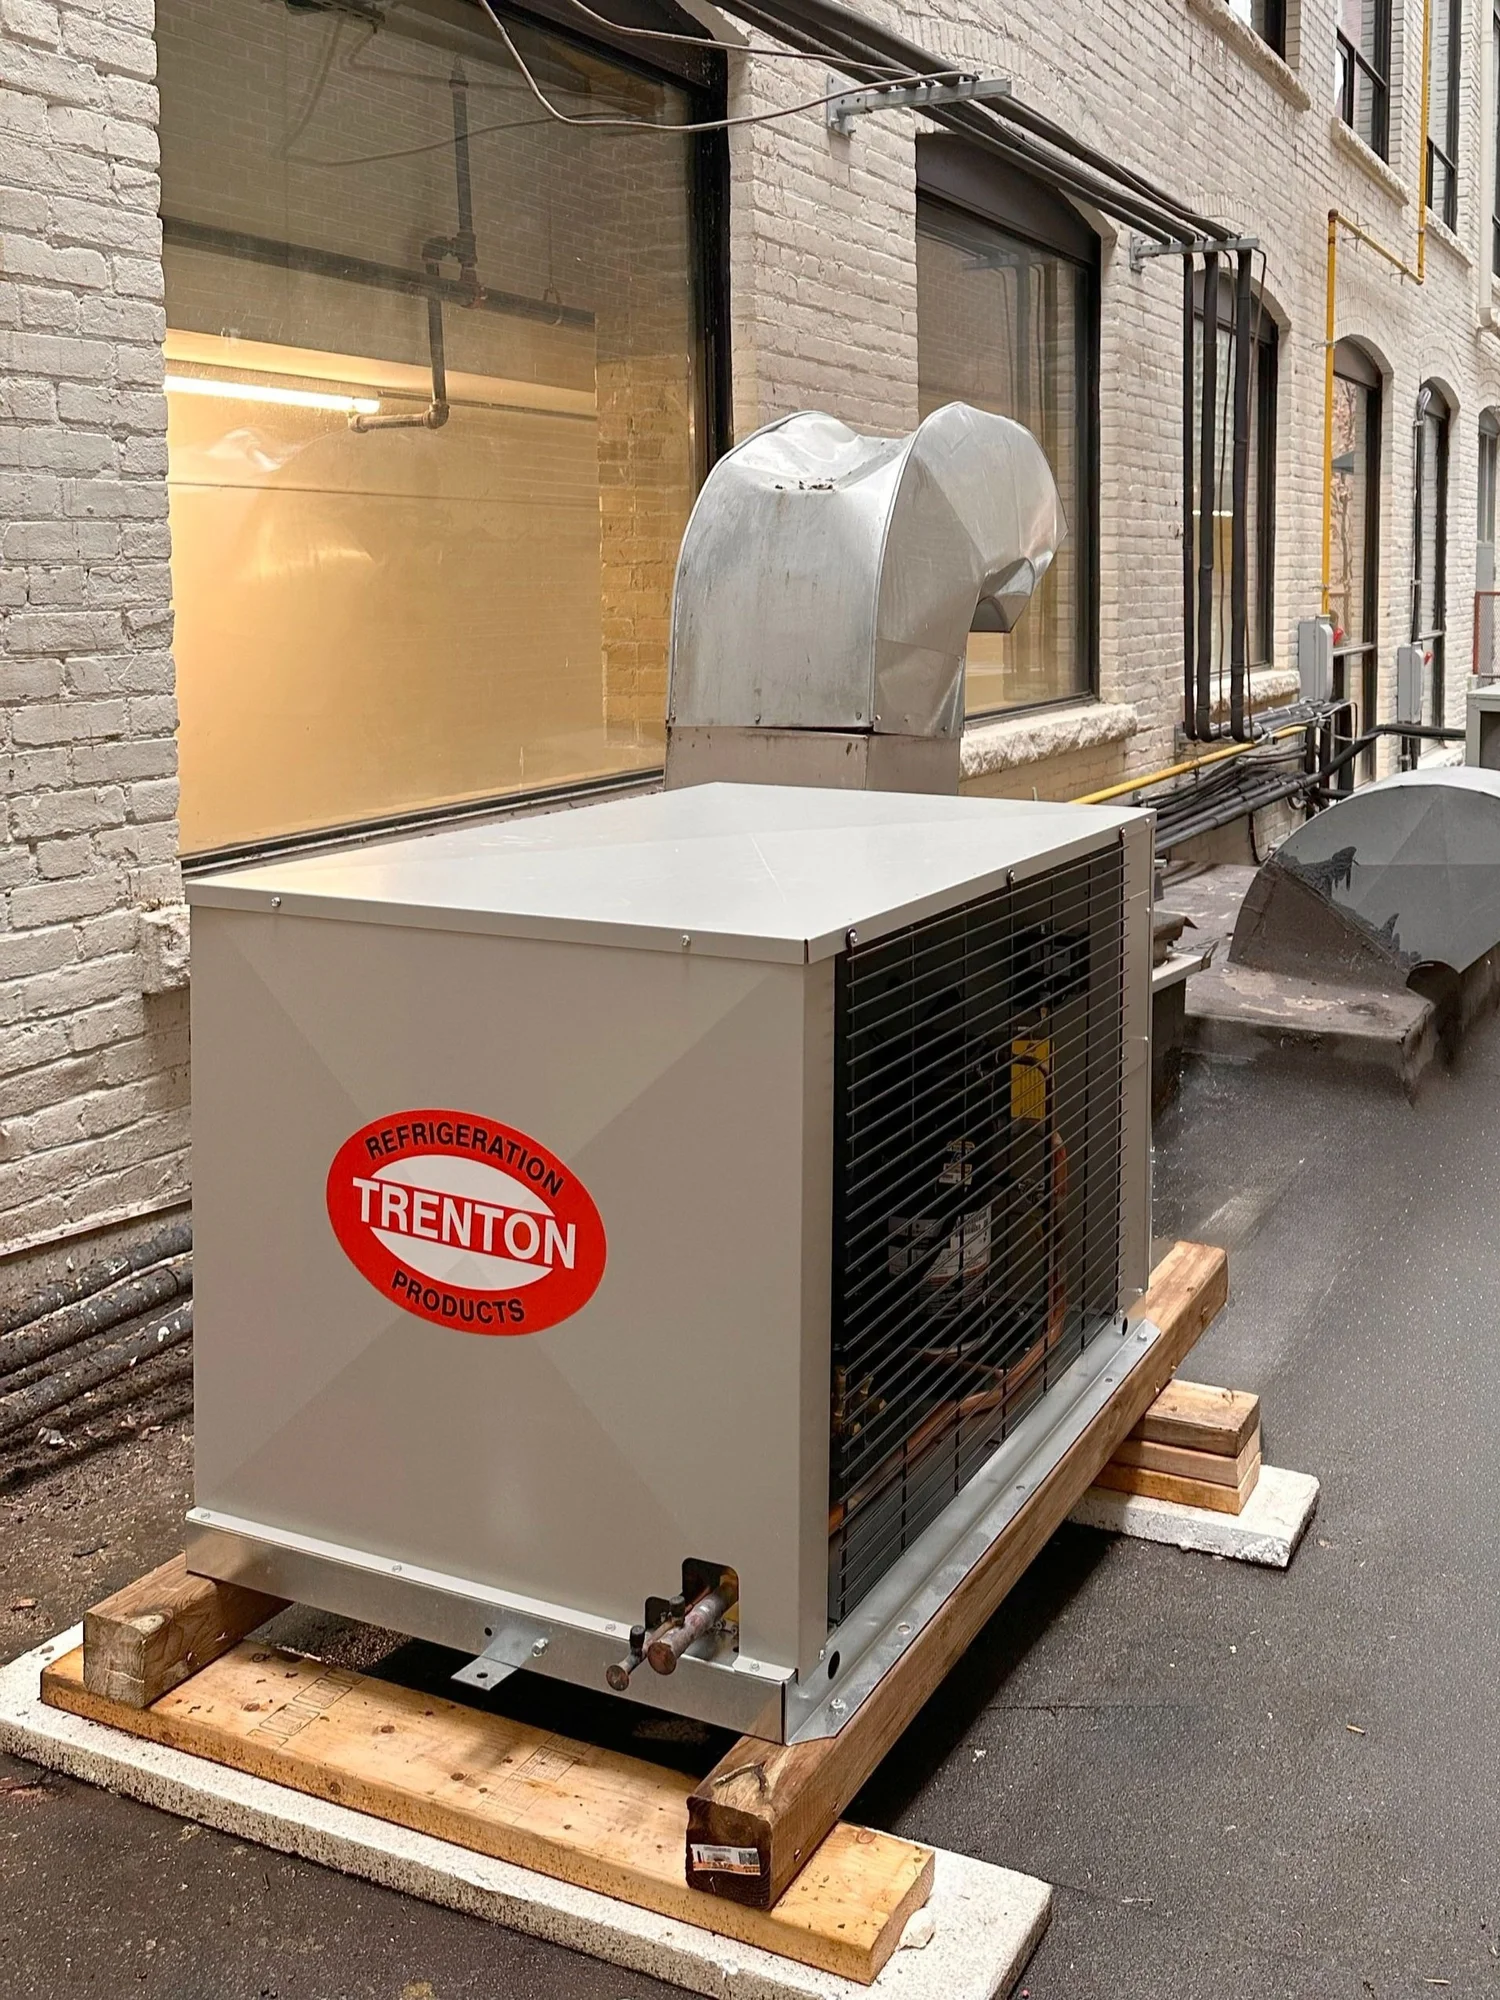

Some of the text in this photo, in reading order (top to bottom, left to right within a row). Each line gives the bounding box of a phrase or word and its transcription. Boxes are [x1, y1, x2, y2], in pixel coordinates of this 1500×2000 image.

[364, 1121, 565, 1197] REFRIGERATION
[352, 1177, 576, 1270] TRENTON
[391, 1269, 526, 1325] PRODUCTS
